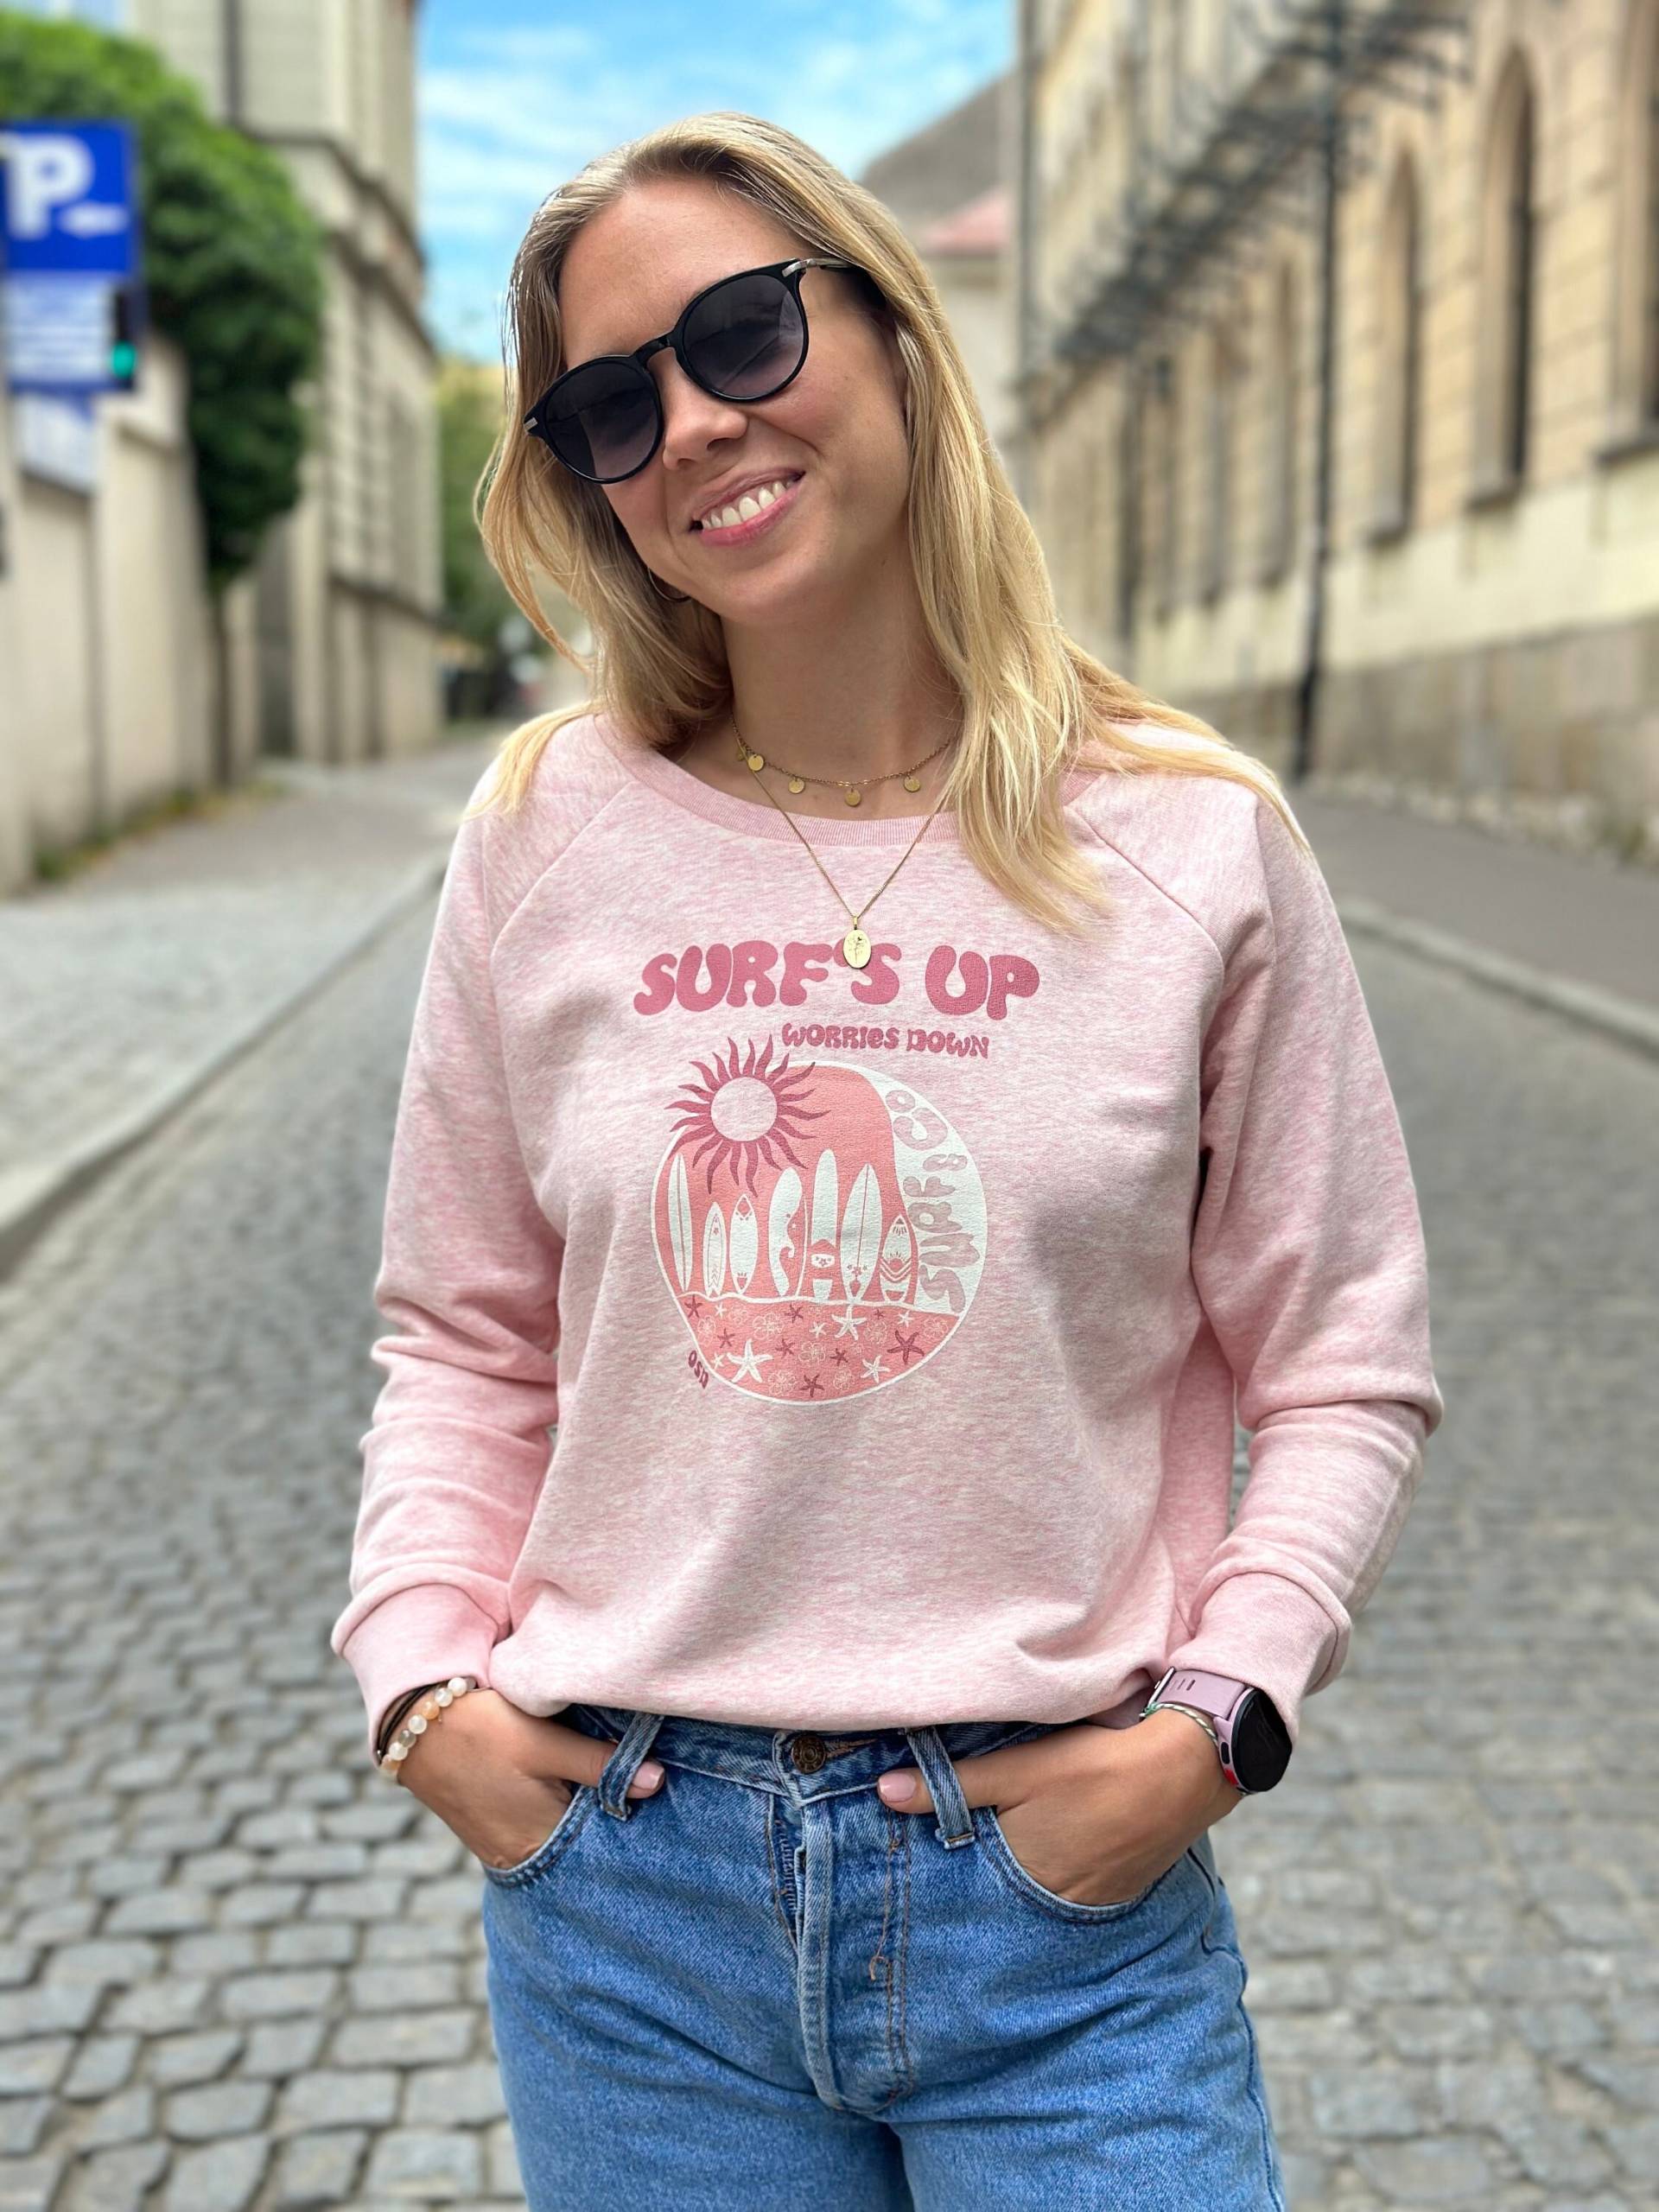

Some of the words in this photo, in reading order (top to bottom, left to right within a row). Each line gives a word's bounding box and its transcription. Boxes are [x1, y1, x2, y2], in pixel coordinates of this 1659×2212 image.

[7, 133, 93, 239] P
[925, 944, 1040, 1021] UP
[906, 1028, 990, 1059] DOWN
[902, 1175, 981, 1313] SURF
